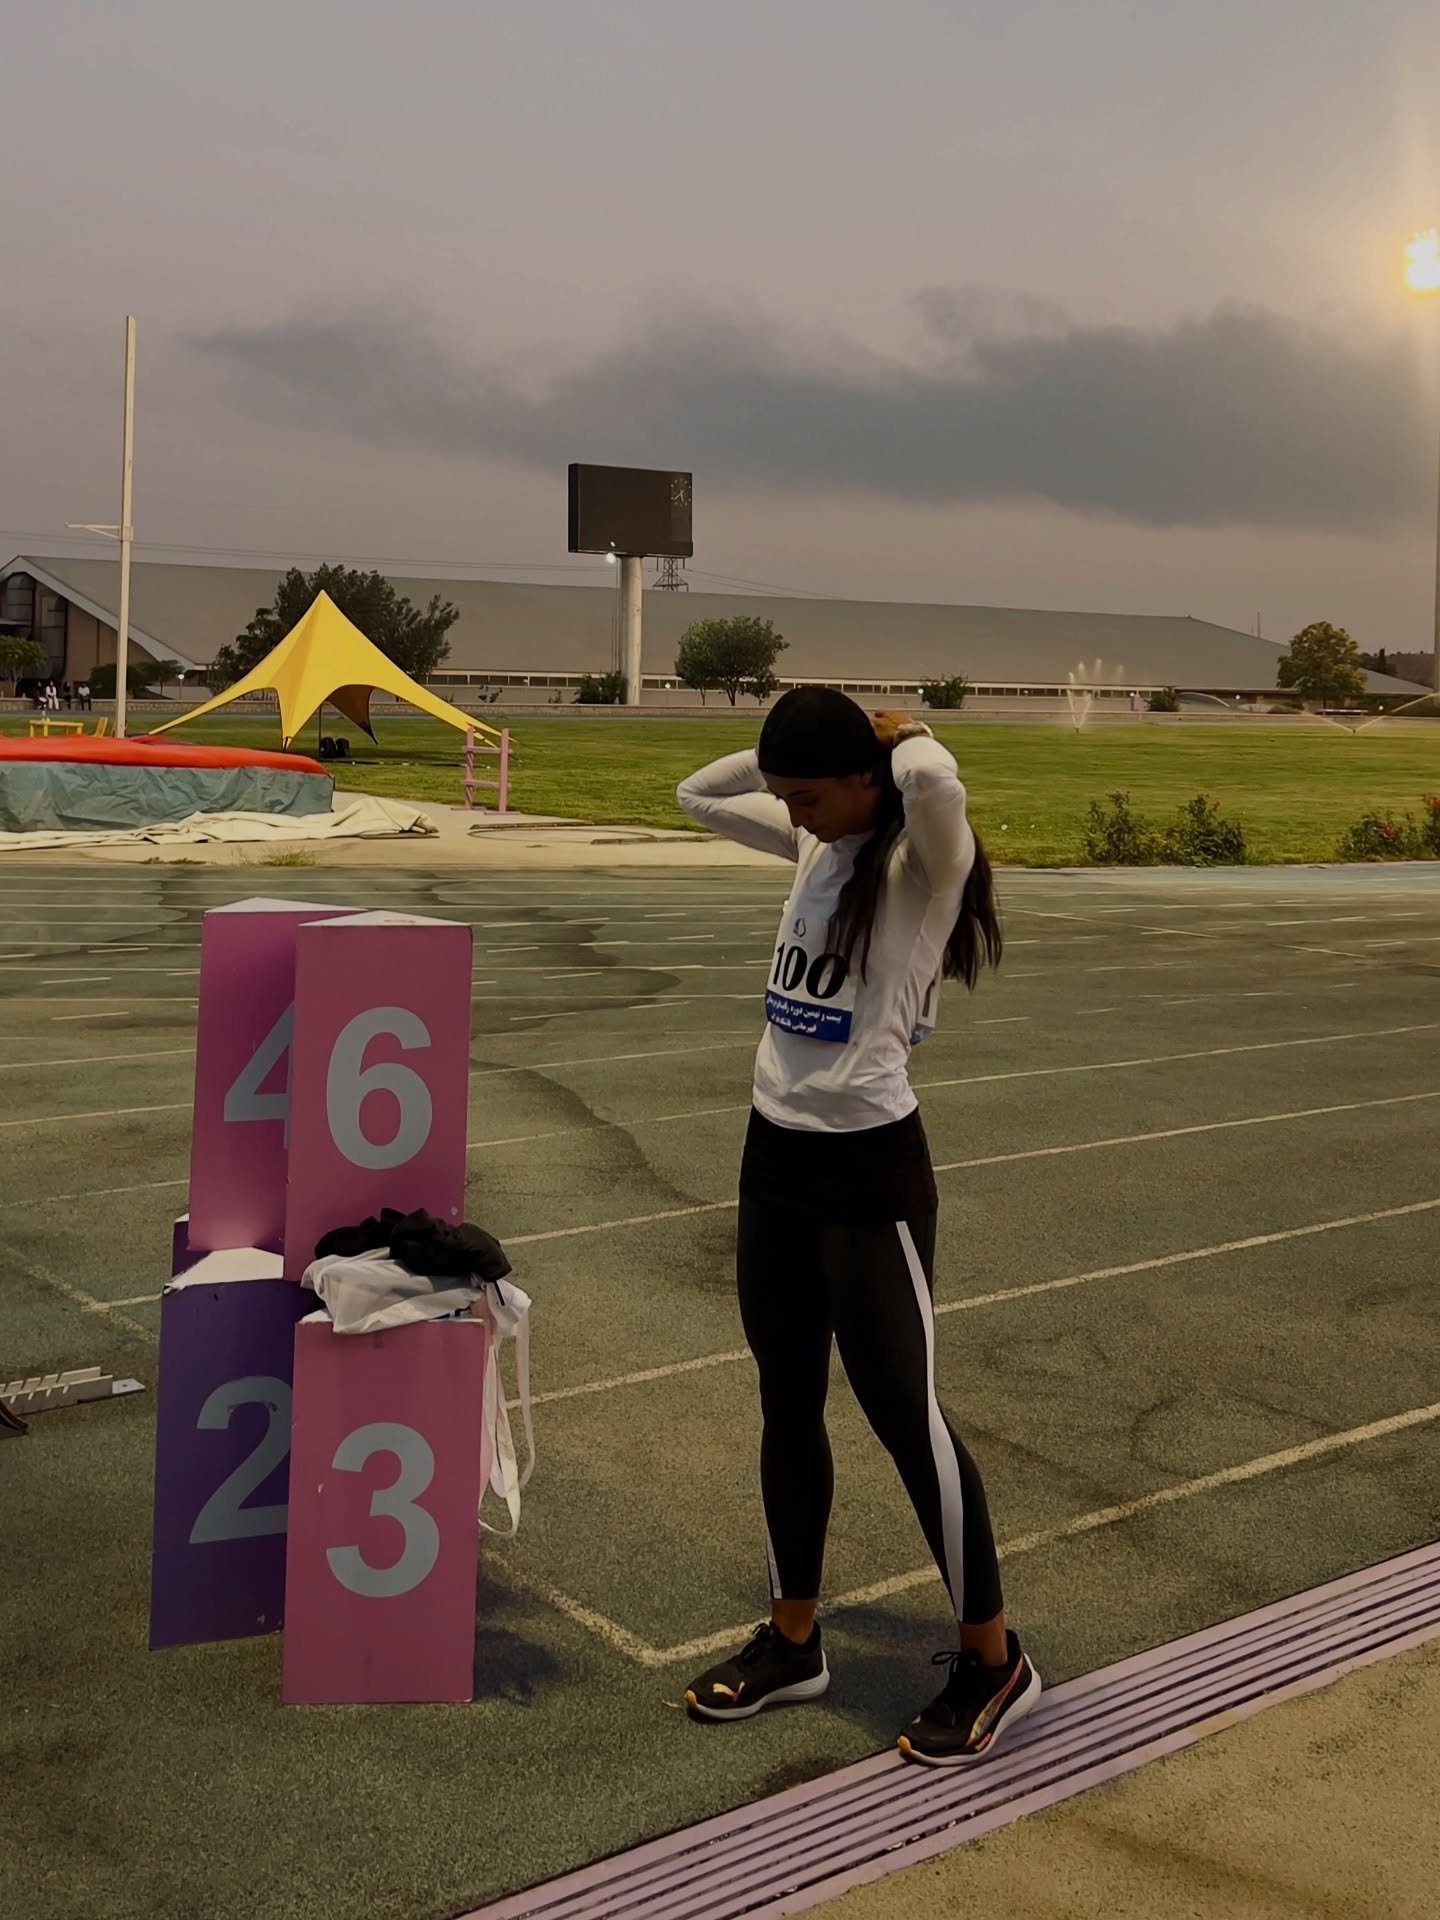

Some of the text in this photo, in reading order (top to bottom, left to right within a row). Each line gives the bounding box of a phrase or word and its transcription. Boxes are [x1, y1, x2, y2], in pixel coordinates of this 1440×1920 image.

[772, 941, 848, 999] 100
[223, 1000, 294, 1149] 4
[326, 1005, 433, 1170] 6
[189, 1375, 292, 1545] 2
[325, 1421, 441, 1598] 3
